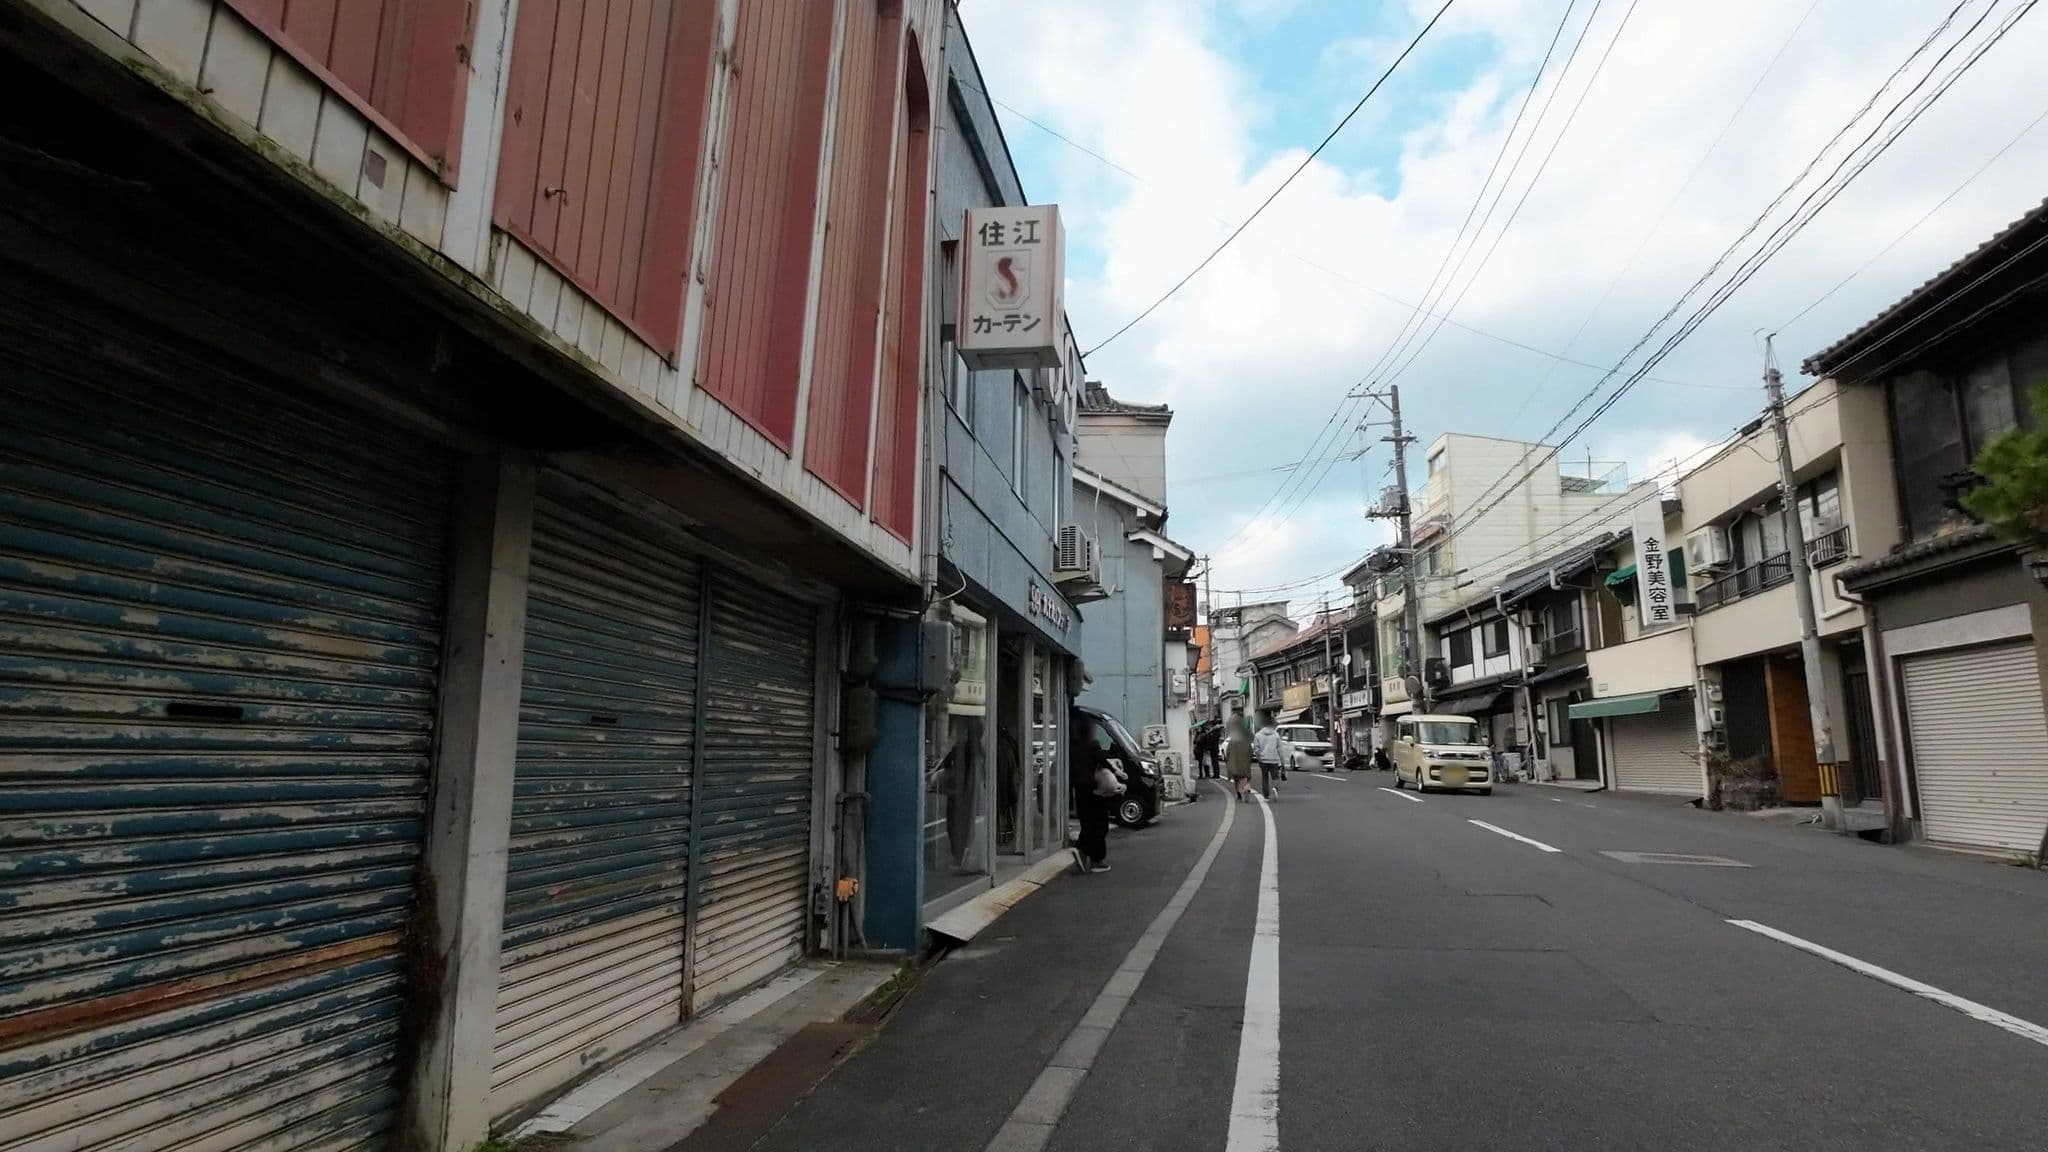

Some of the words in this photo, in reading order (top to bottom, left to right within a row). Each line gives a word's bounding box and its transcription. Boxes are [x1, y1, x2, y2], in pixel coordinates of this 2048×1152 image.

[978, 219, 1041, 247] 住江
[973, 313, 1042, 334] カーテン
[1643, 536, 1670, 621] 金野美容室
